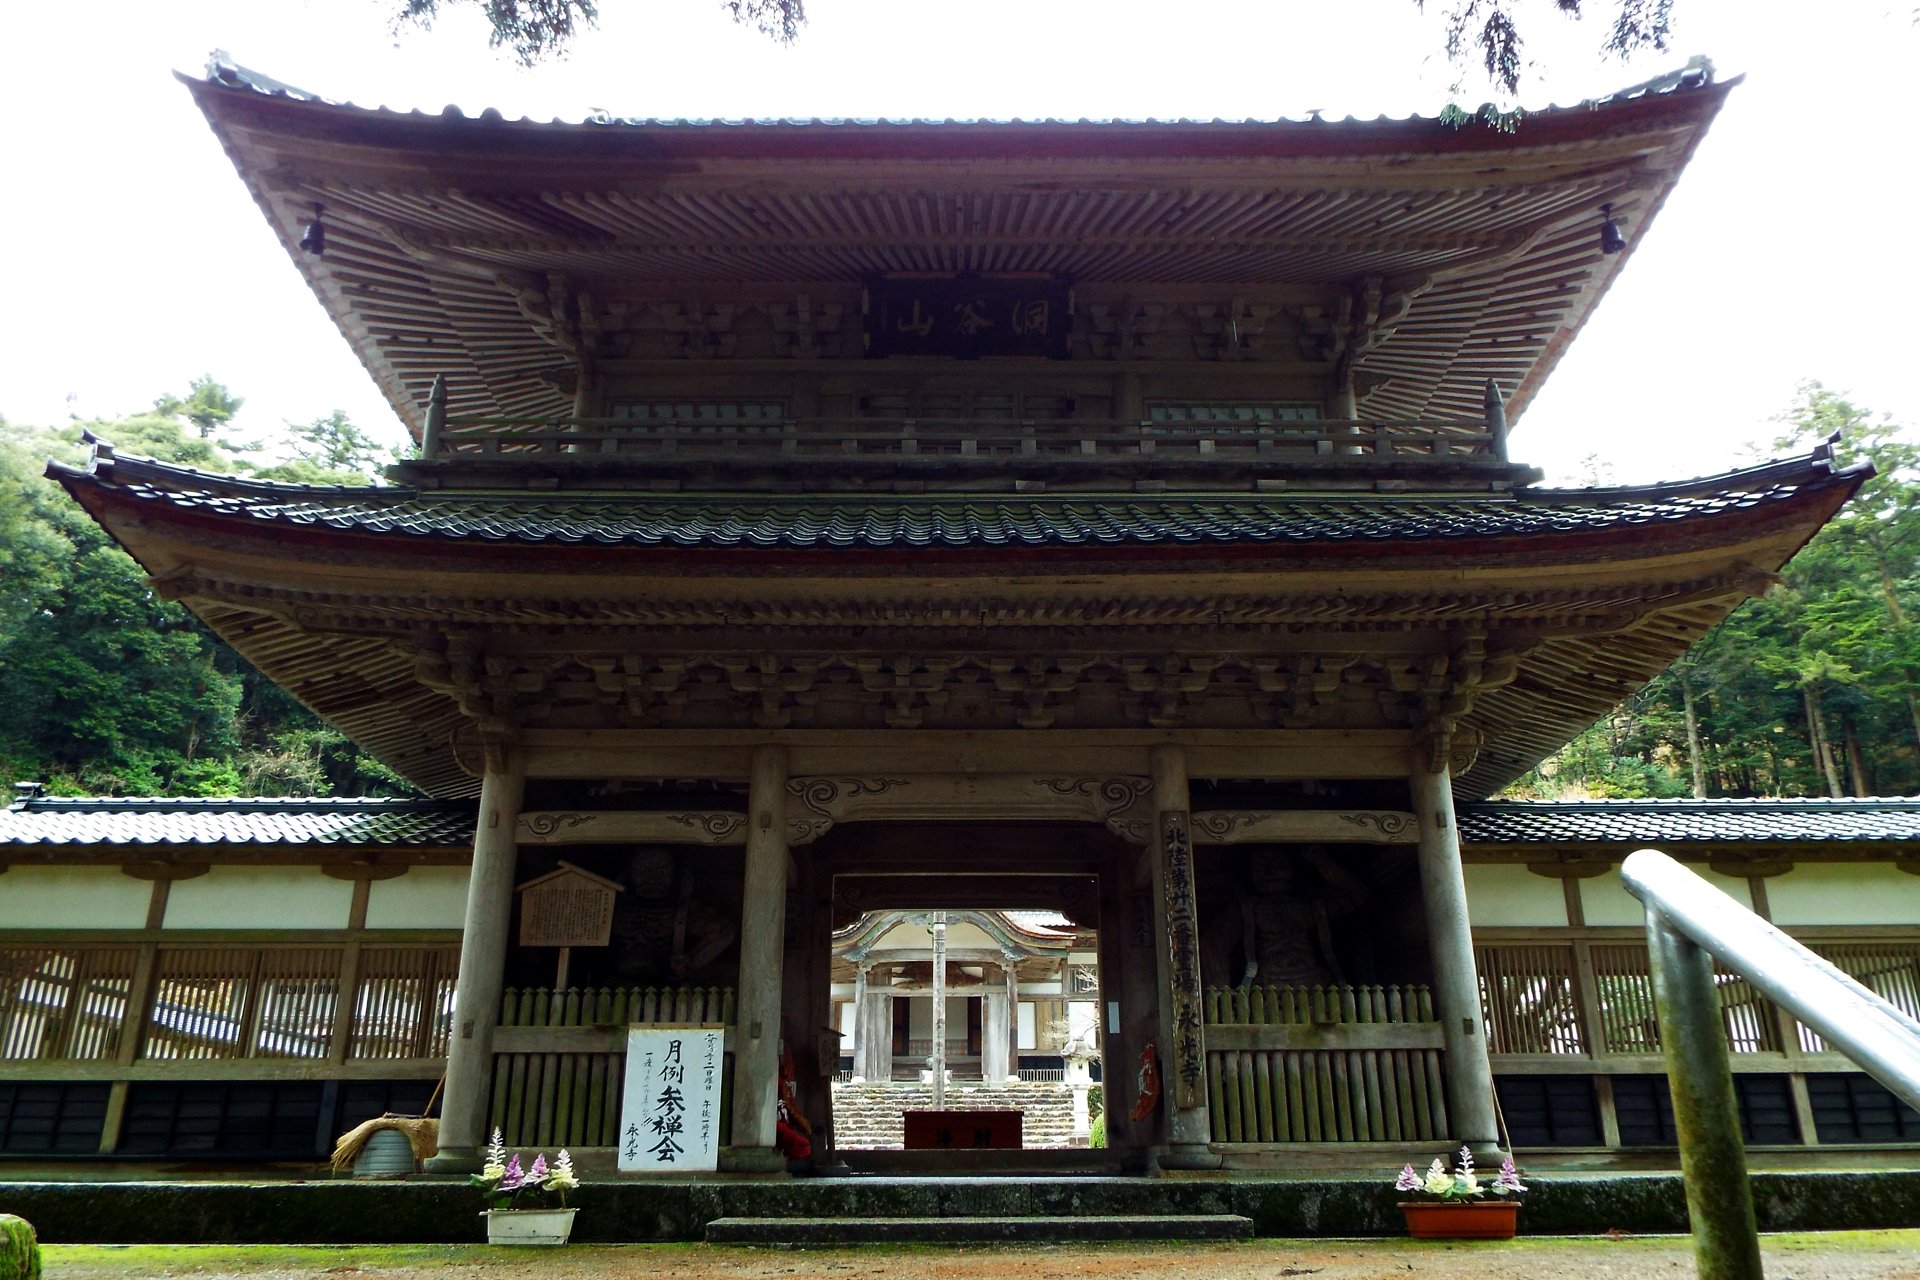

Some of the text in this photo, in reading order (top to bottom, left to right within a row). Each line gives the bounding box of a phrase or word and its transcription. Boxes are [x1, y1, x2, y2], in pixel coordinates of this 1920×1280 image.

[646, 1039, 686, 1163] 月例参禅会
[624, 1123, 640, 1161] 永光寺
